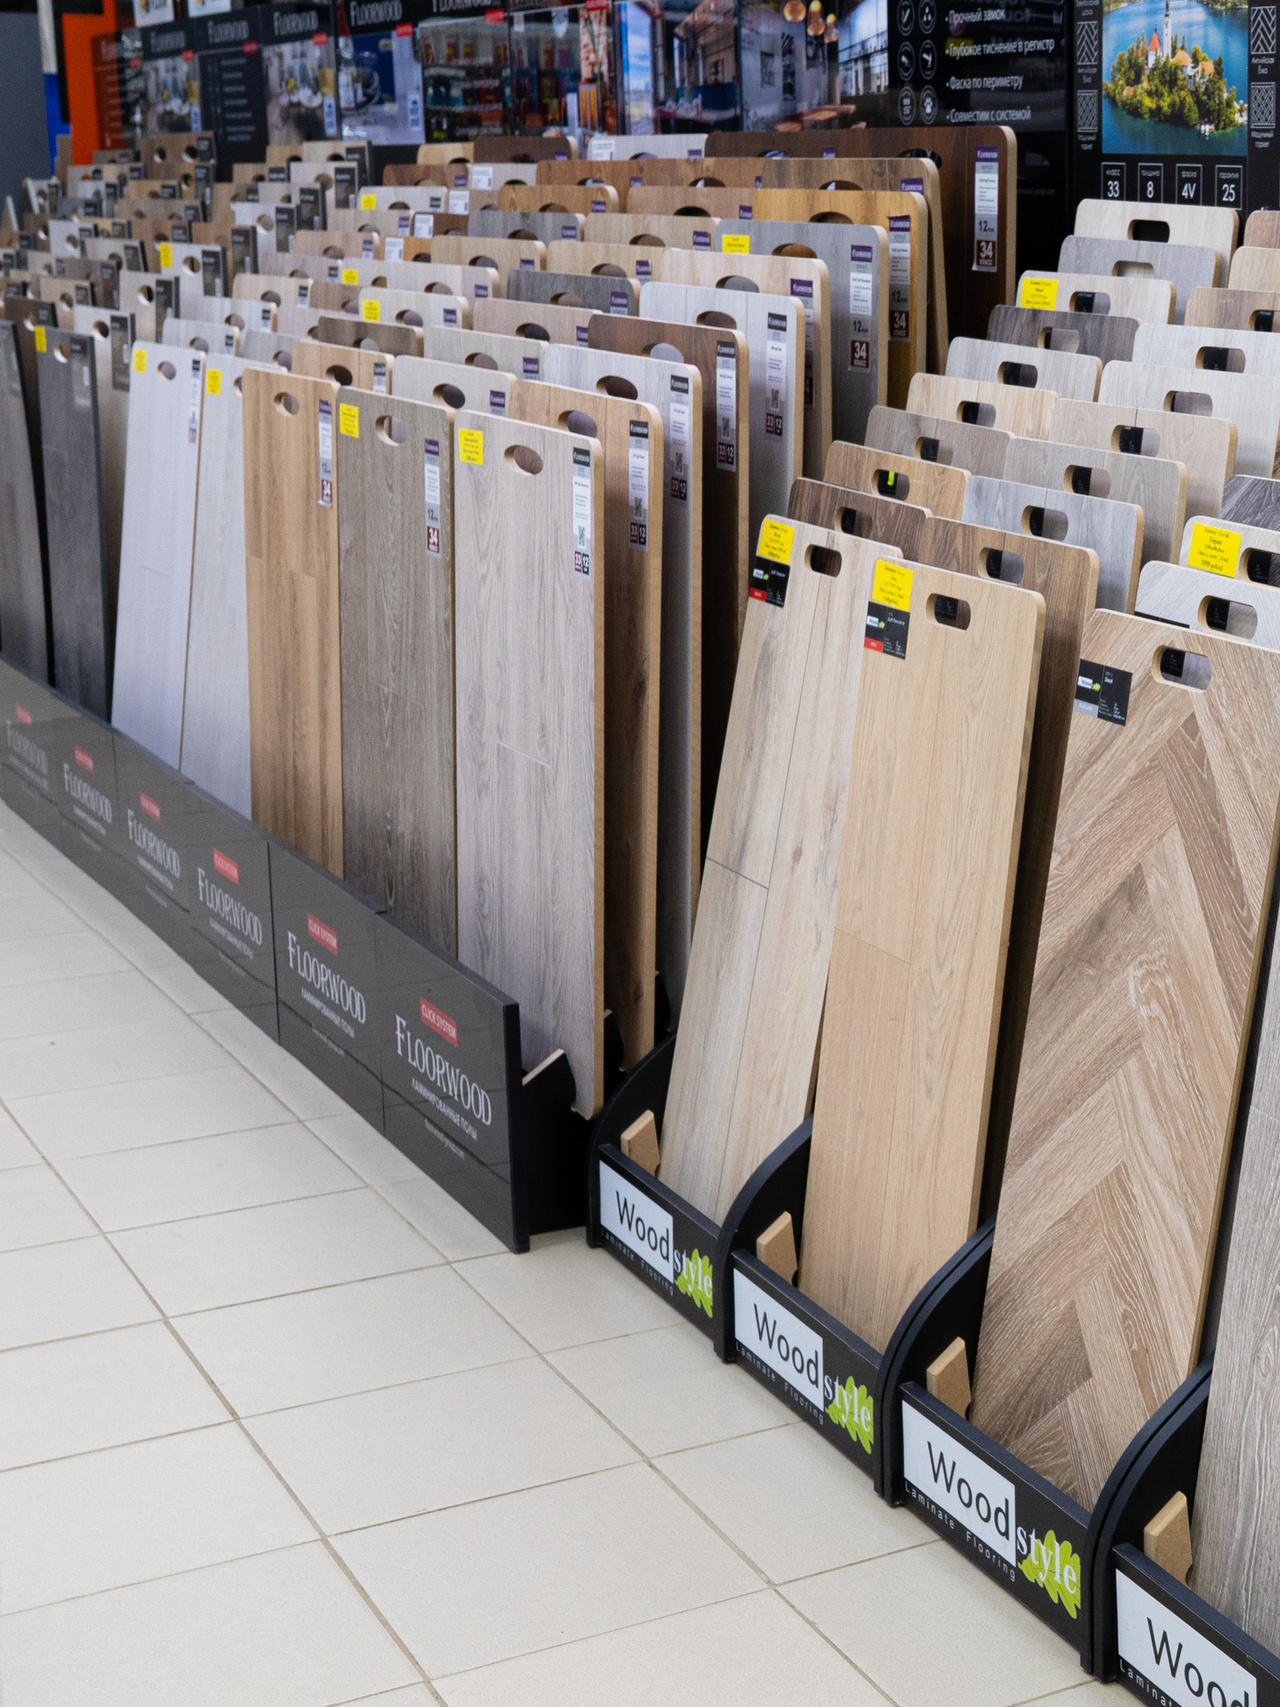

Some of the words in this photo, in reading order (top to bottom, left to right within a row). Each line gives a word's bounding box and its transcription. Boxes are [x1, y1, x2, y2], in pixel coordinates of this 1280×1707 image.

[1107, 181, 1120, 198] 33
[1146, 182, 1154, 198] 8
[1222, 184, 1236, 202] 25
[980, 242, 993, 258] 34
[854, 343, 867, 359] 34
[128, 808, 180, 879] FLOORWOOD
[198, 866, 262, 946] FLOORWOOD
[288, 931, 366, 1025] FLOORWOOD
[421, 1004, 435, 1022] CLICK
[436, 1014, 457, 1040] SYSTEM
[395, 1014, 492, 1126] FLOORWOOD
[601, 1226, 634, 1262] Laminate
[641, 1259, 674, 1297] Flooring
[736, 1340, 776, 1382] Laminate
[784, 1380, 824, 1425] Flooring
[904, 1480, 956, 1530] Laminate
[966, 1533, 1016, 1582] Flooring
